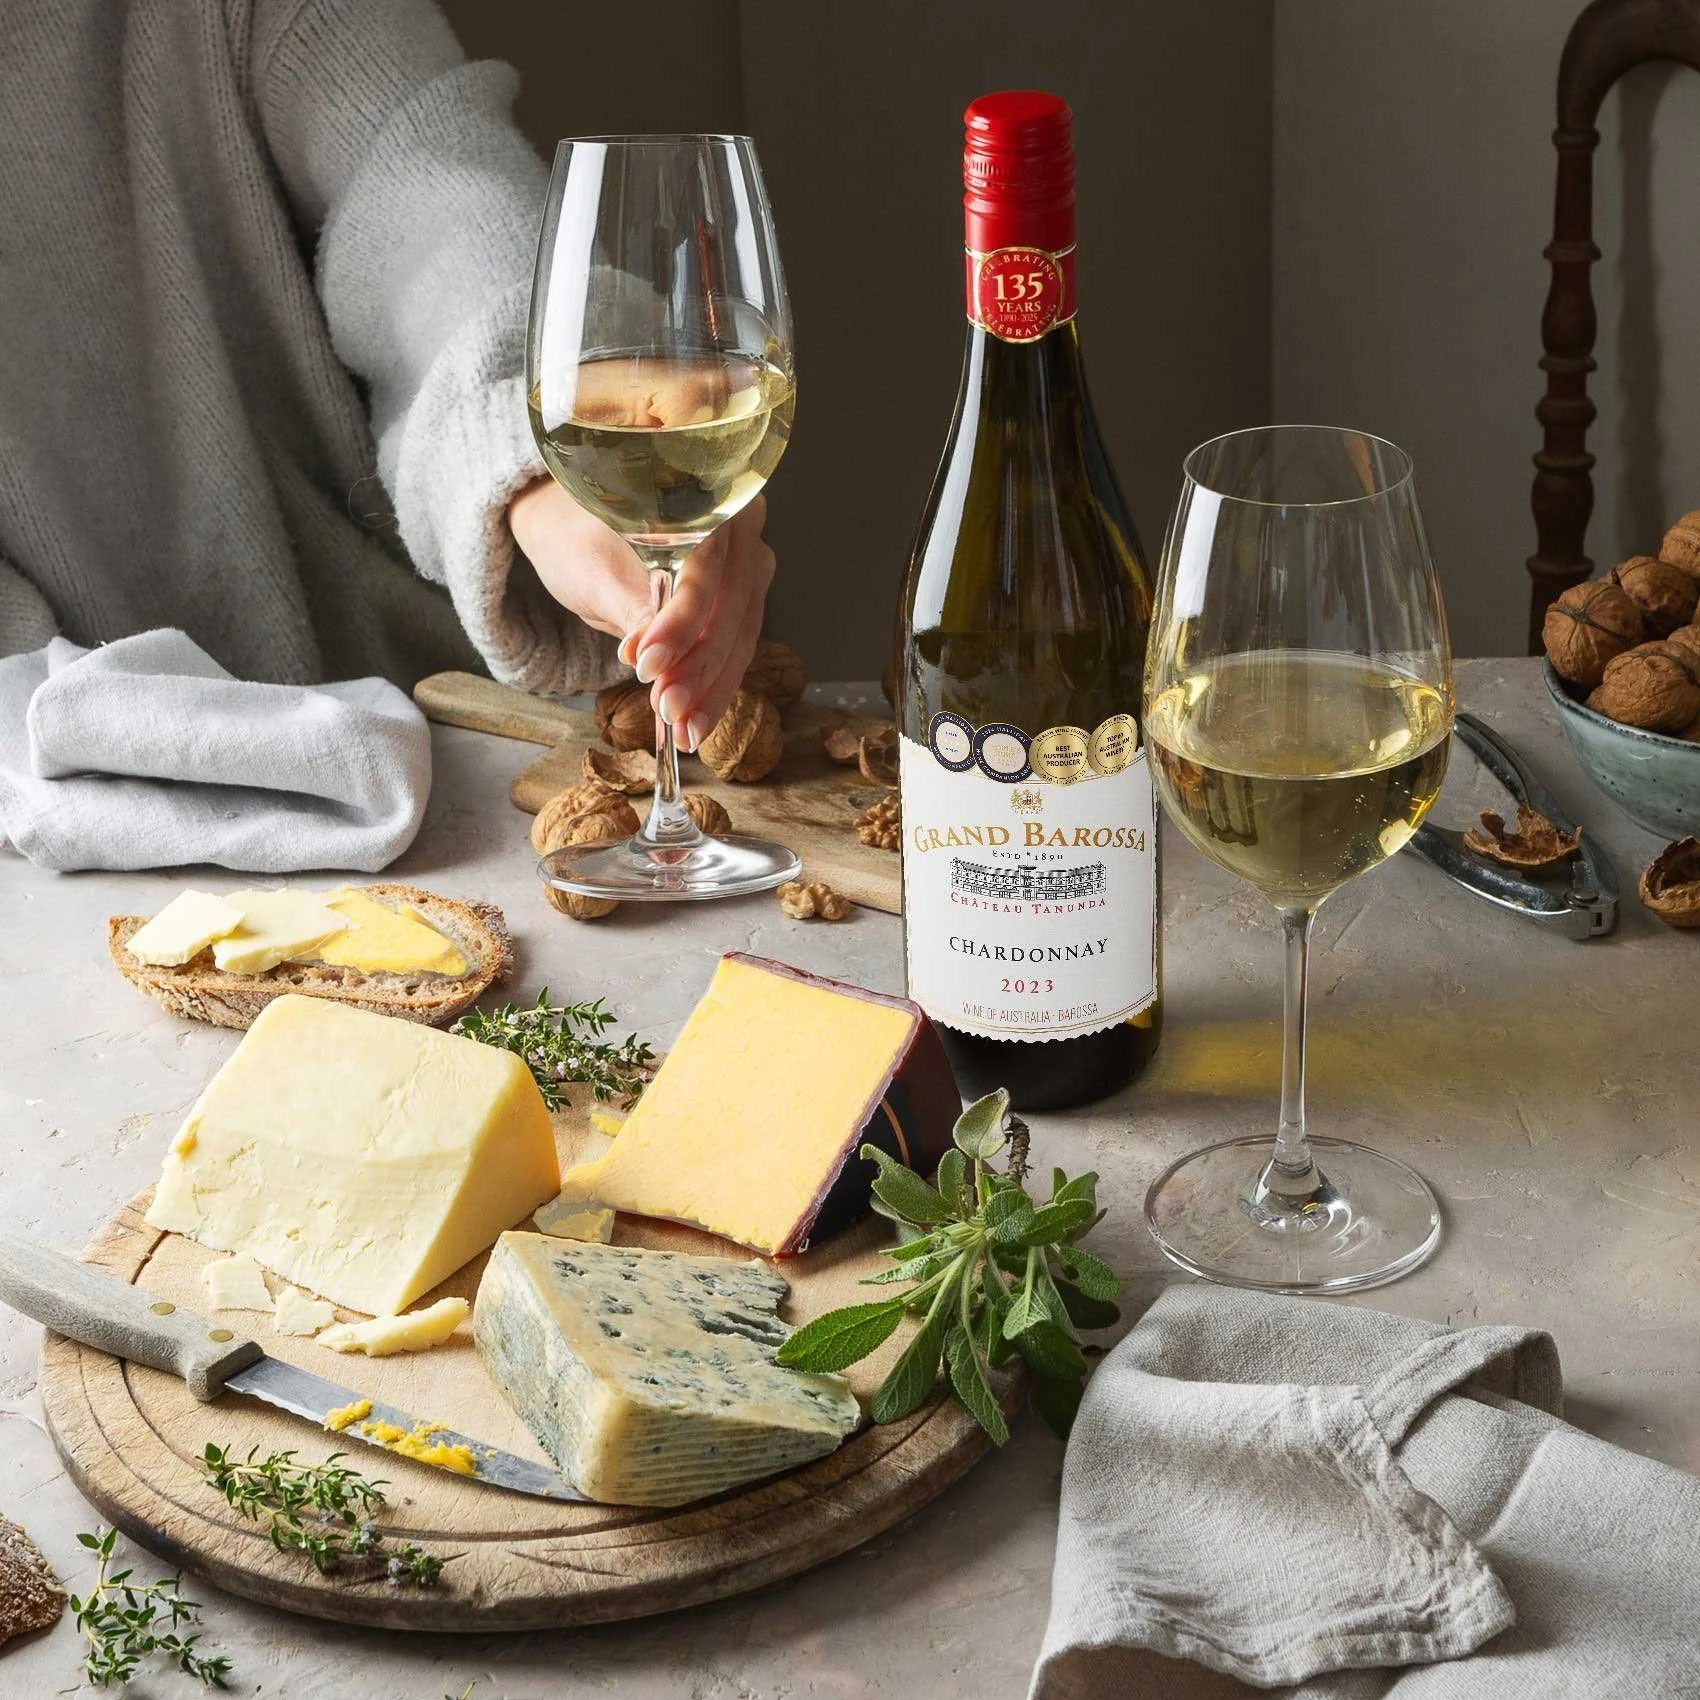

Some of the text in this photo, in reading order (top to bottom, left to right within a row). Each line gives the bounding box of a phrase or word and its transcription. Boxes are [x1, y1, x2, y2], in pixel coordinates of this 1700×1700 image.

[992, 272, 1043, 300] 135
[998, 301, 1041, 313] YEARS
[1043, 751, 1083, 760] AUSTRALIAN
[1046, 759, 1081, 767] PRODUCER
[914, 822, 1145, 853] GRAND BAROSSA
[1034, 853, 1064, 861] 1890
[1032, 897, 1107, 915] TANUNDA
[949, 936, 1109, 963] CHARDONNAY
[1001, 978, 1054, 994] 2023
[962, 1001, 1098, 1024] WINE OF AUSTRALIA BAROSSA
